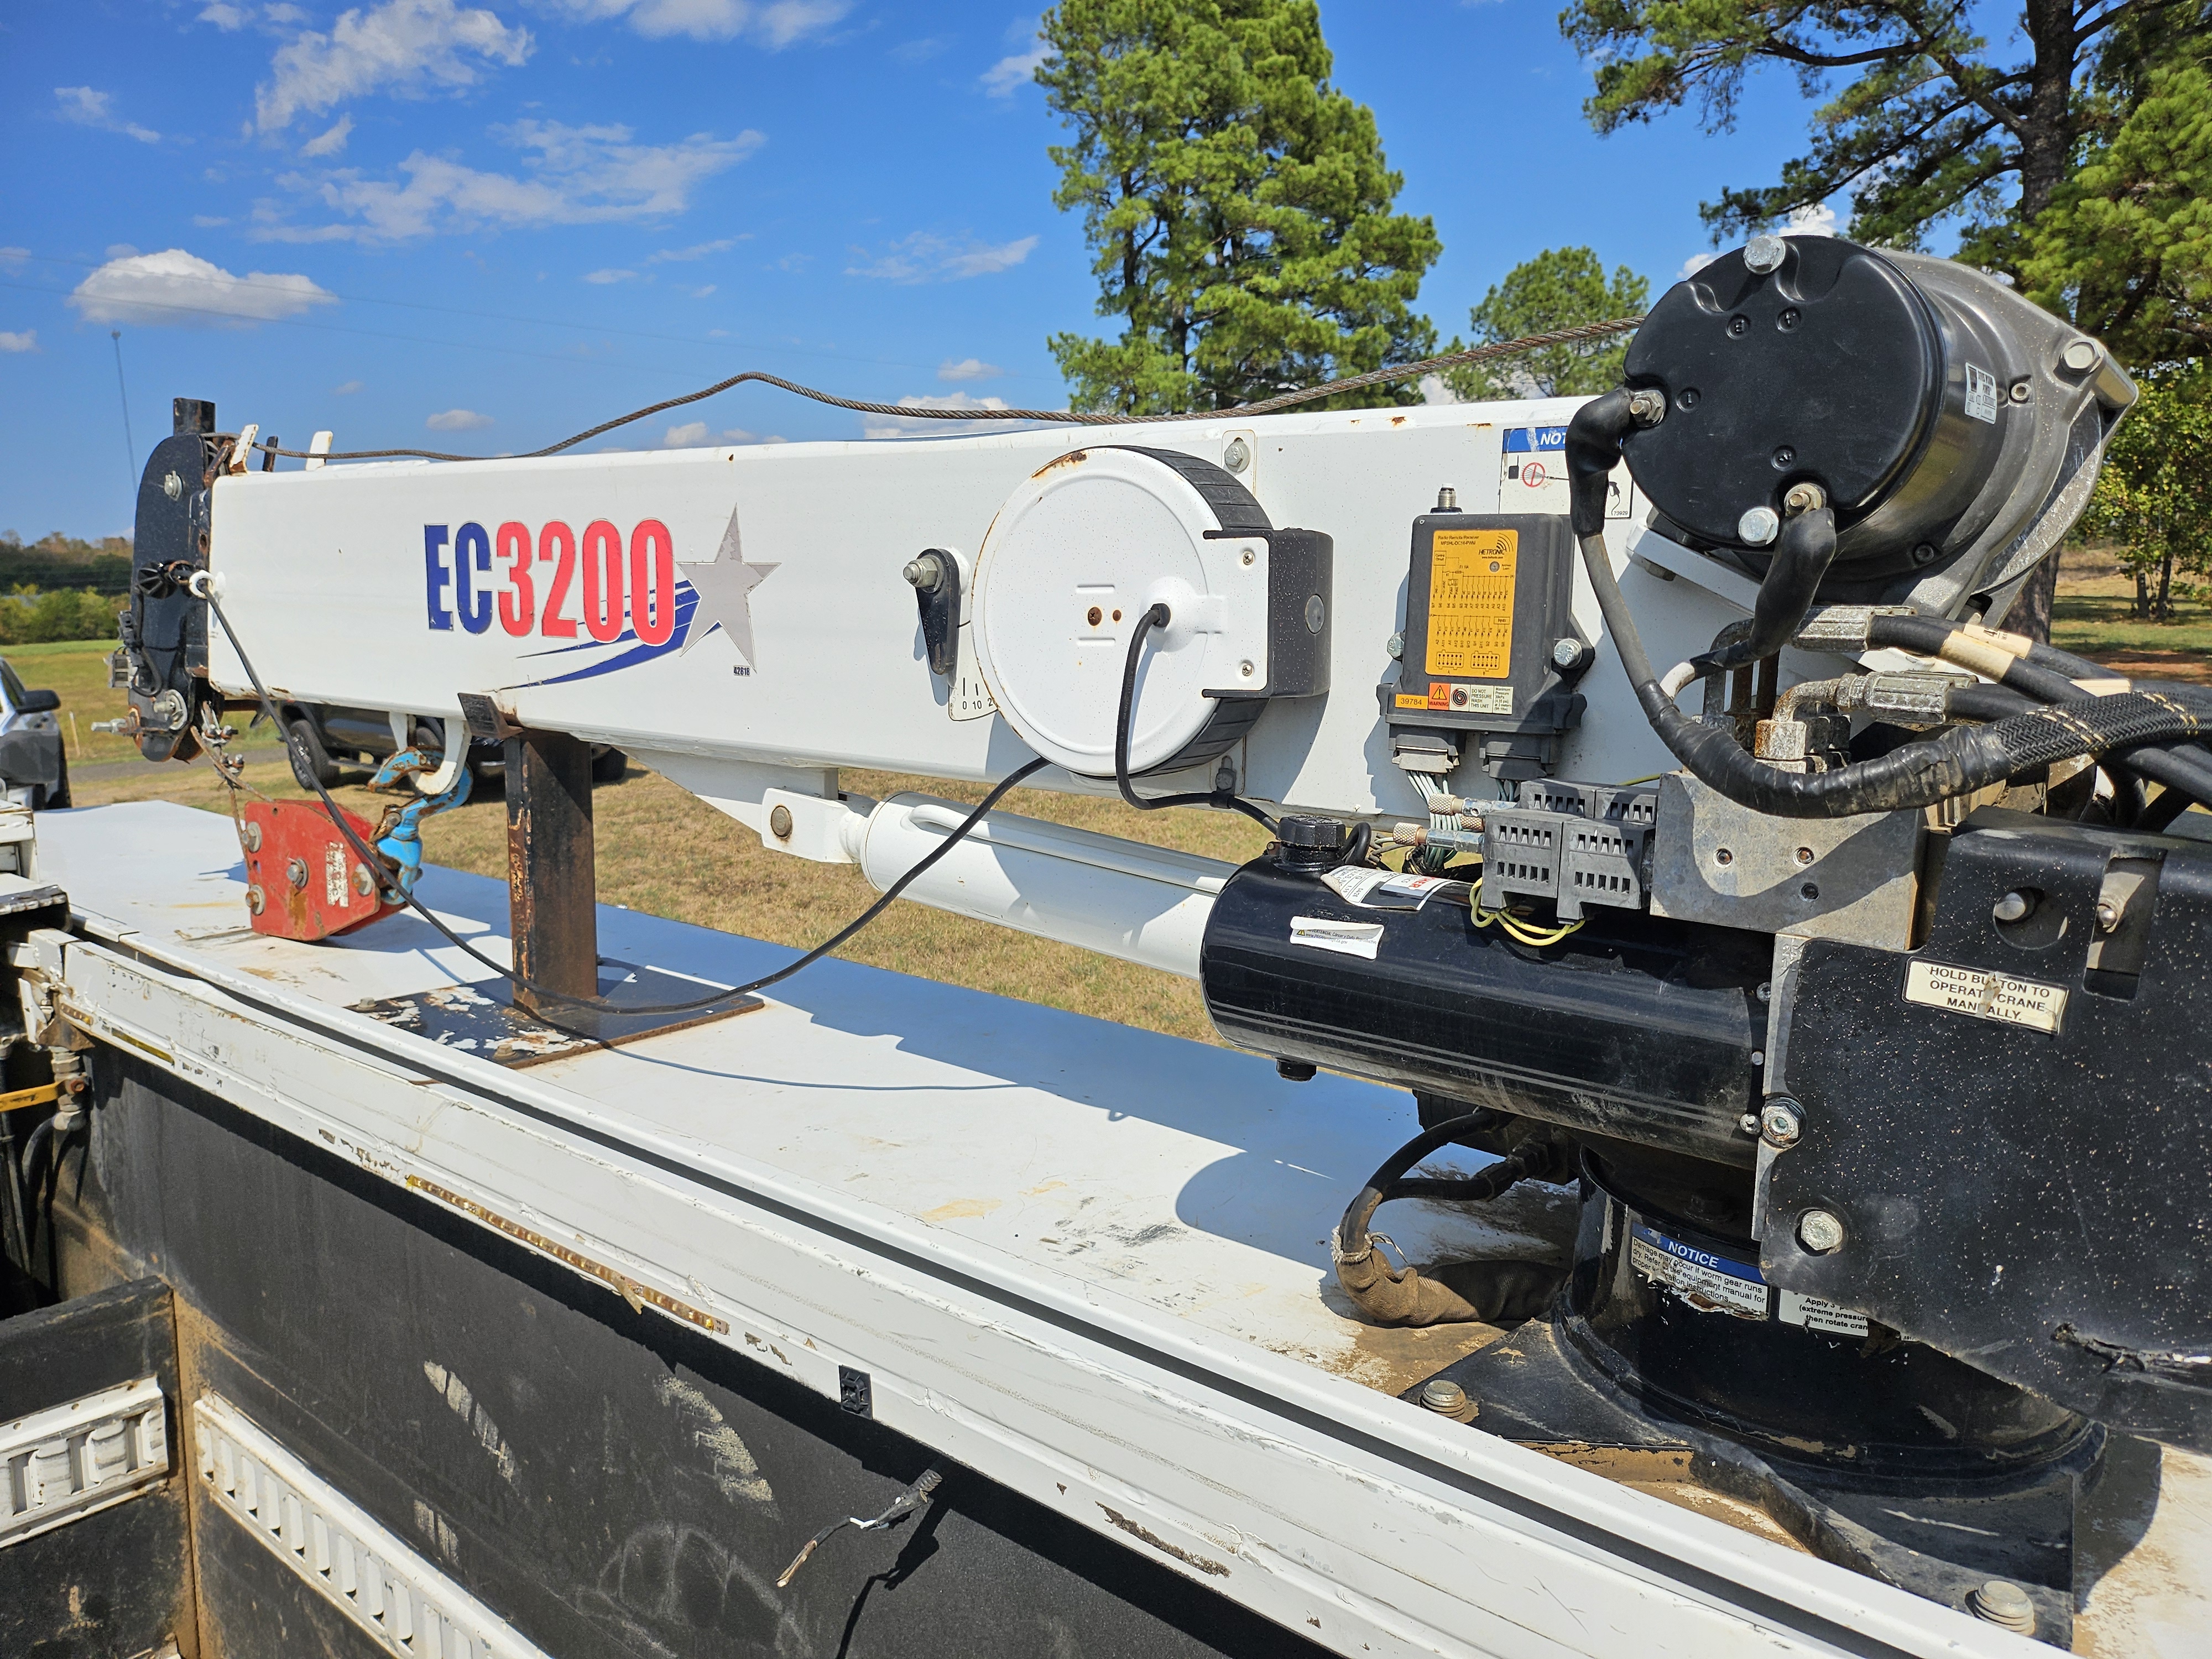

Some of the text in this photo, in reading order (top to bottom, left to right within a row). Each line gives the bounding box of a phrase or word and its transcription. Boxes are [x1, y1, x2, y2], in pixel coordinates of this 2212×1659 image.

[424, 518, 675, 646] EC3200
[734, 667, 750, 676] 42818
[962, 697, 993, 709] 0 10 2
[1930, 967, 2049, 998] HOLD BUTON TO
[1930, 980, 2045, 1011] OPERAT CRANE
[1947, 997, 2021, 1020] MANALLY.
[1632, 1258, 1651, 1270] proper
[1634, 1239, 1657, 1256] Damage
[1659, 1253, 1673, 1263] may
[1673, 1260, 1693, 1271] occur
[1695, 1265, 1699, 1274] if
[1702, 1270, 1722, 1282] worm
[1724, 1278, 1743, 1288] gear
[1745, 1284, 1762, 1293] runs
[1668, 1241, 1719, 1268] NOTICE
[1633, 1249, 1642, 1258] dry.
[1645, 1253, 1661, 1266] Refer
[1670, 1266, 1681, 1275] the
[1723, 1286, 1752, 1300] manual
[1754, 1295, 1765, 1303] for
[1799, 1305, 1833, 1316] (extreme
[1805, 1297, 1828, 1308] Apply
[1806, 1314, 1823, 1323] then
[1825, 1319, 1848, 1328] rotate
